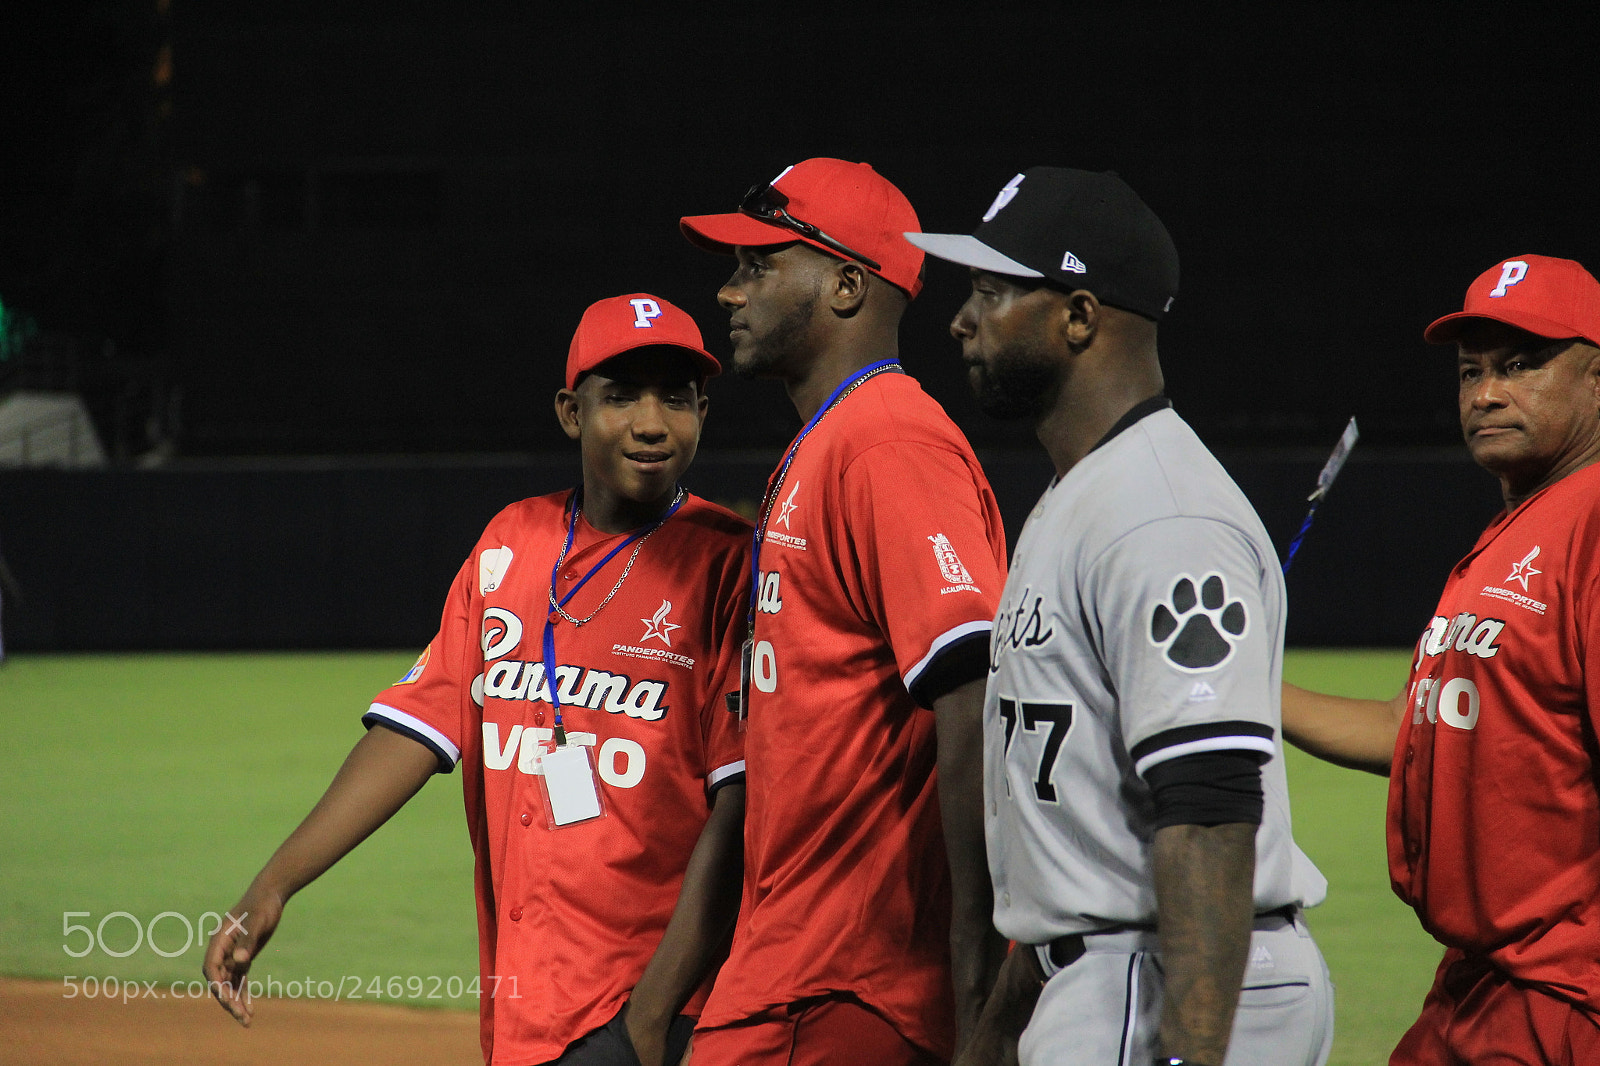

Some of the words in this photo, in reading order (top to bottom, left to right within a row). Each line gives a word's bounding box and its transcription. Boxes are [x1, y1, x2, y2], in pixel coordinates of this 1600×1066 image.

[1488, 260, 1530, 298] P
[628, 298, 663, 328] P
[470, 606, 670, 721] Panama
[612, 643, 696, 666] PANDEPORTES
